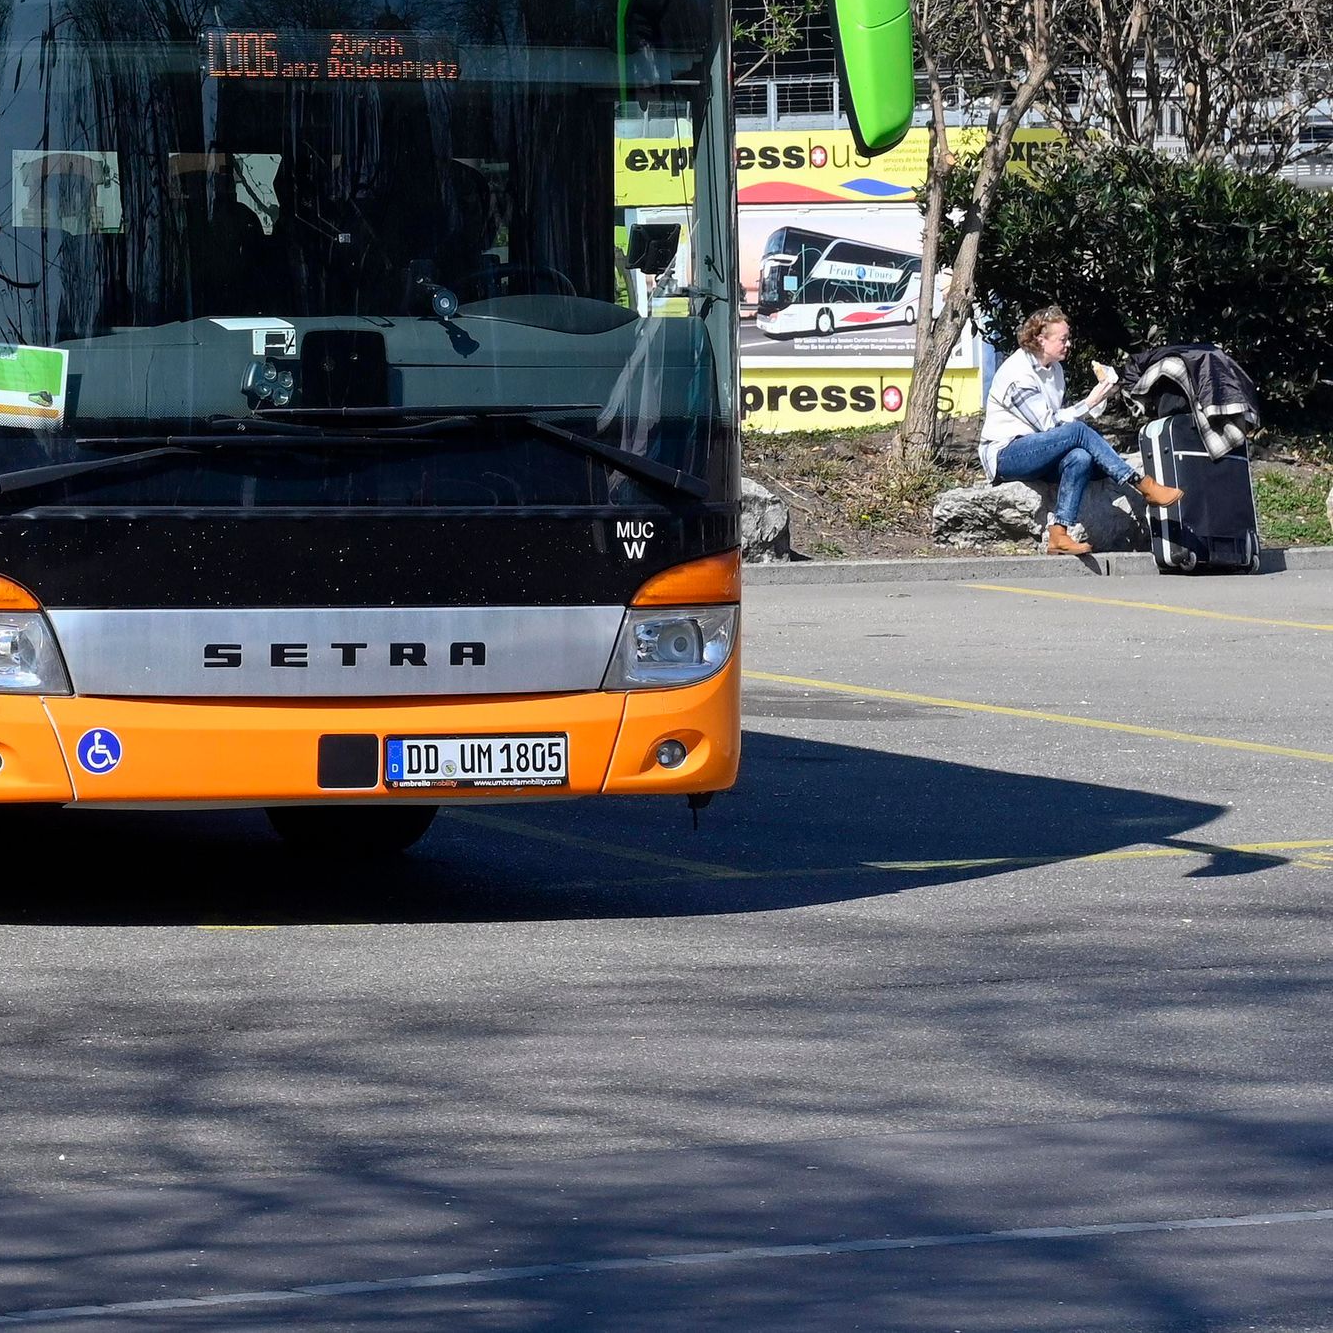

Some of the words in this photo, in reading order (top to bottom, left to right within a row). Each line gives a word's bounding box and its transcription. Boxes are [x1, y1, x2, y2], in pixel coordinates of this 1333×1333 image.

[616, 521, 654, 538] MUC
[623, 541, 646, 559] W
[204, 643, 496, 667] SETRA
[406, 744, 439, 775] DD
[460, 743, 493, 774] UM
[499, 742, 562, 773] 1805
[391, 764, 399, 773] D
